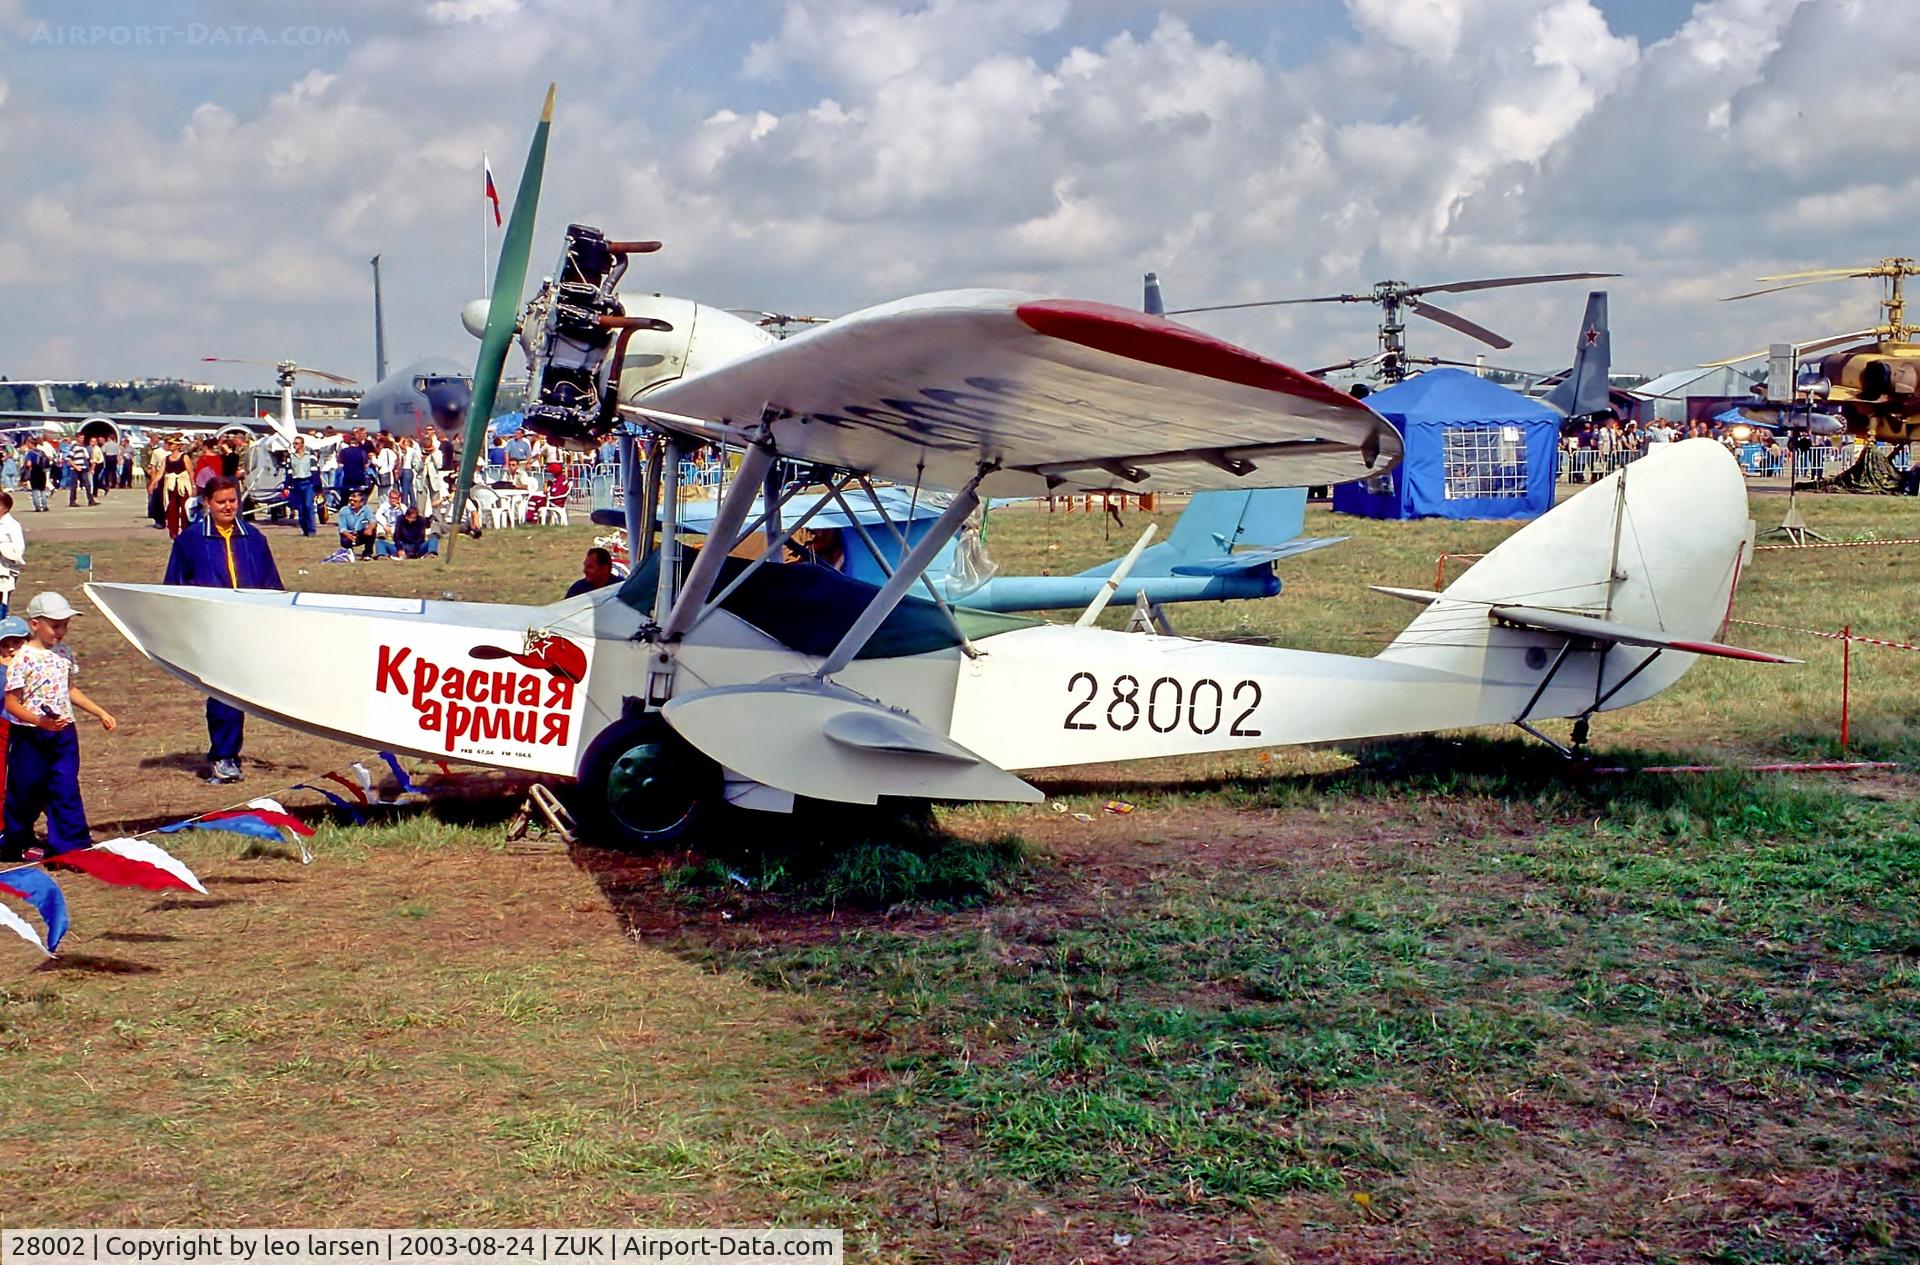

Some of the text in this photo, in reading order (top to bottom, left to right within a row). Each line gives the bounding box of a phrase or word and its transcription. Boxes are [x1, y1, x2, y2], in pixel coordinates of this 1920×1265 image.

[376, 645, 575, 713] Красная
[1064, 671, 1262, 737] 28002
[418, 698, 570, 752] армия
